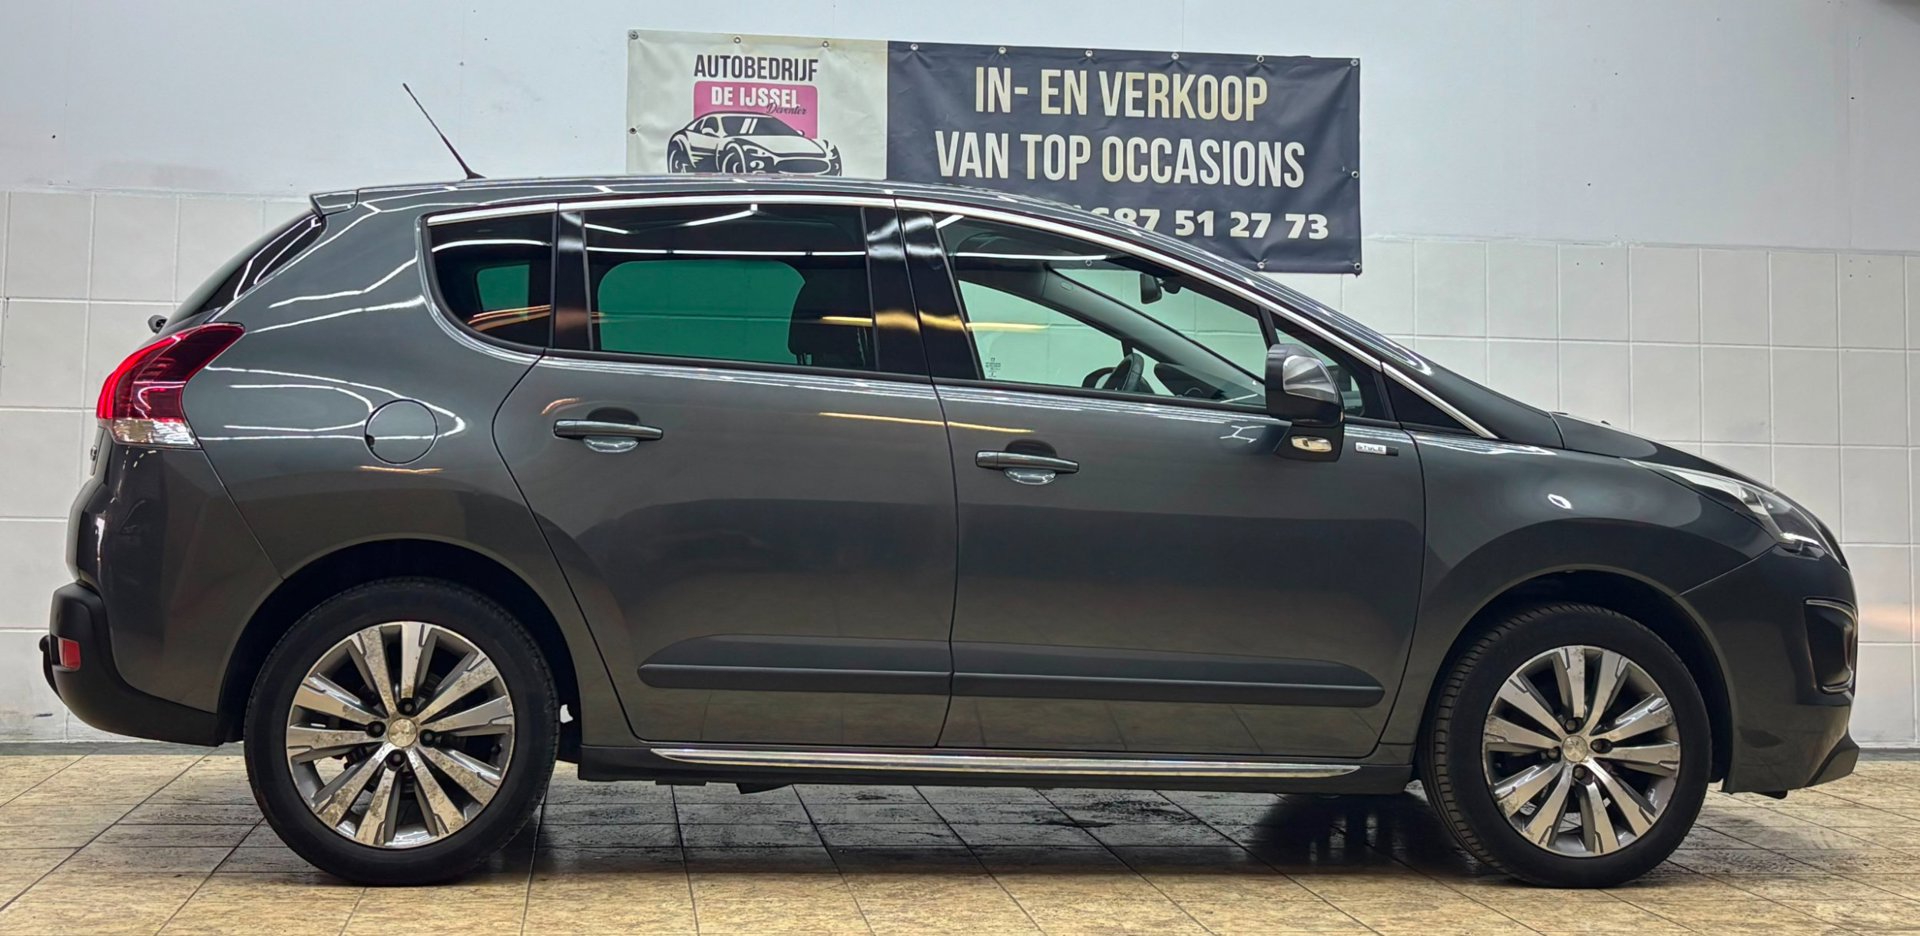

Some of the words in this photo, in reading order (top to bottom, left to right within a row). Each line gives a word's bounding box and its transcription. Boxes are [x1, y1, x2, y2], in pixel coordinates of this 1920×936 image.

[694, 54, 819, 82] AUTOBEDRIJF
[711, 86, 734, 106] DE
[740, 87, 800, 109] IJSSEL
[975, 66, 1028, 113] IN-
[1041, 69, 1087, 116] EN
[1099, 71, 1268, 122] VERKOOP
[935, 130, 1009, 179] VAN
[1020, 134, 1091, 181] TOP
[1102, 136, 1305, 189] OCCASIONS
[1175, 209, 1214, 237] 51
[1230, 212, 1271, 239] 27
[1285, 213, 1329, 240] 73
